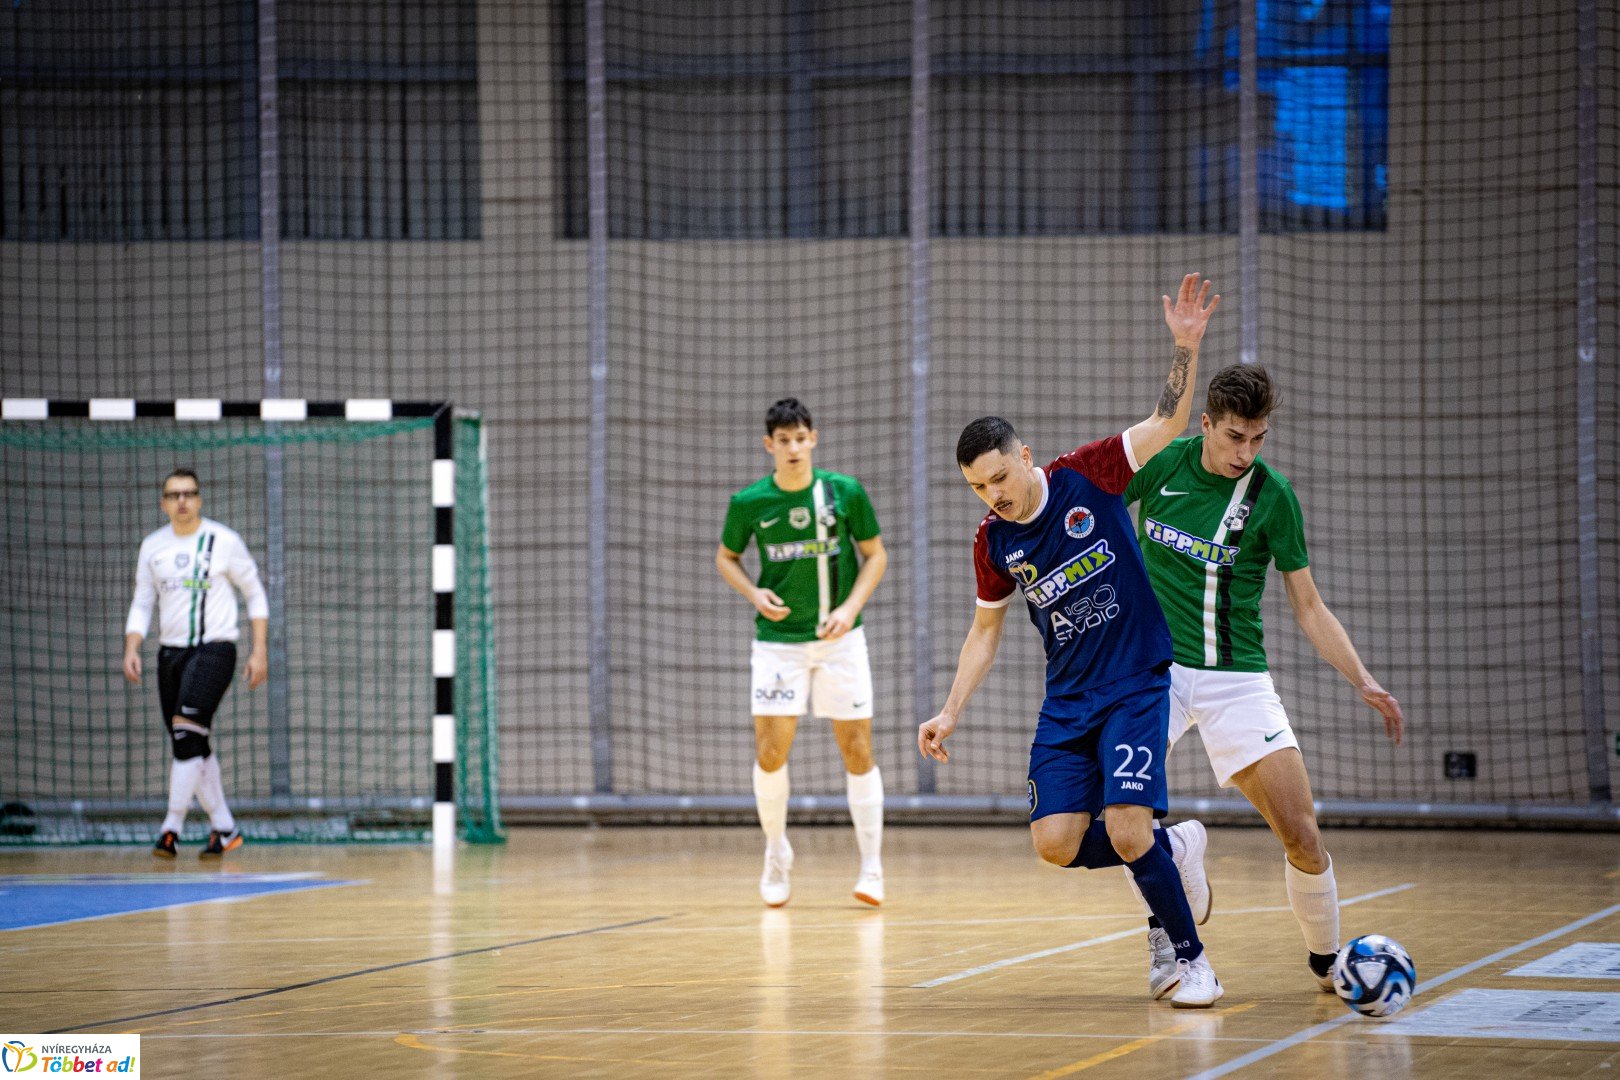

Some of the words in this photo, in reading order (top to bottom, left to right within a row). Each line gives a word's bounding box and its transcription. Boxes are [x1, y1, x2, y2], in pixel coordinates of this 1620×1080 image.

[1005, 549, 1024, 564] JAKO
[1056, 603, 1120, 646] STUDIO
[1113, 744, 1153, 780] 22
[1121, 781, 1144, 791] JAKO
[1173, 940, 1191, 950] AKO
